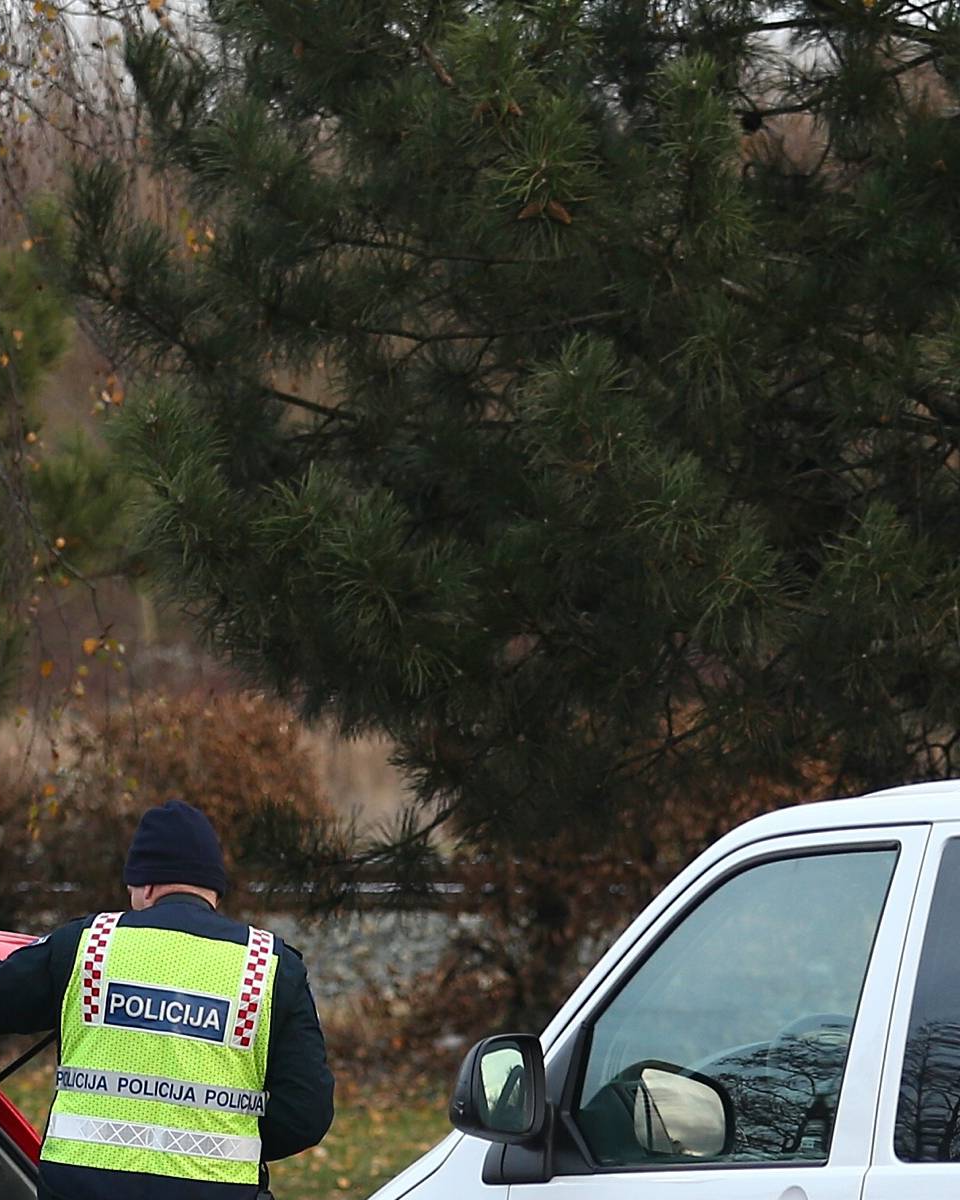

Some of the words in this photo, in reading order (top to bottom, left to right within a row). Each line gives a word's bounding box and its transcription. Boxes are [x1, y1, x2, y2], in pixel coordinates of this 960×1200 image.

[109, 993, 221, 1031] POLICIJA
[56, 1070, 108, 1092] POLICIJA
[117, 1077, 196, 1103] POLICIJA
[204, 1089, 264, 1112] POLICIJA
